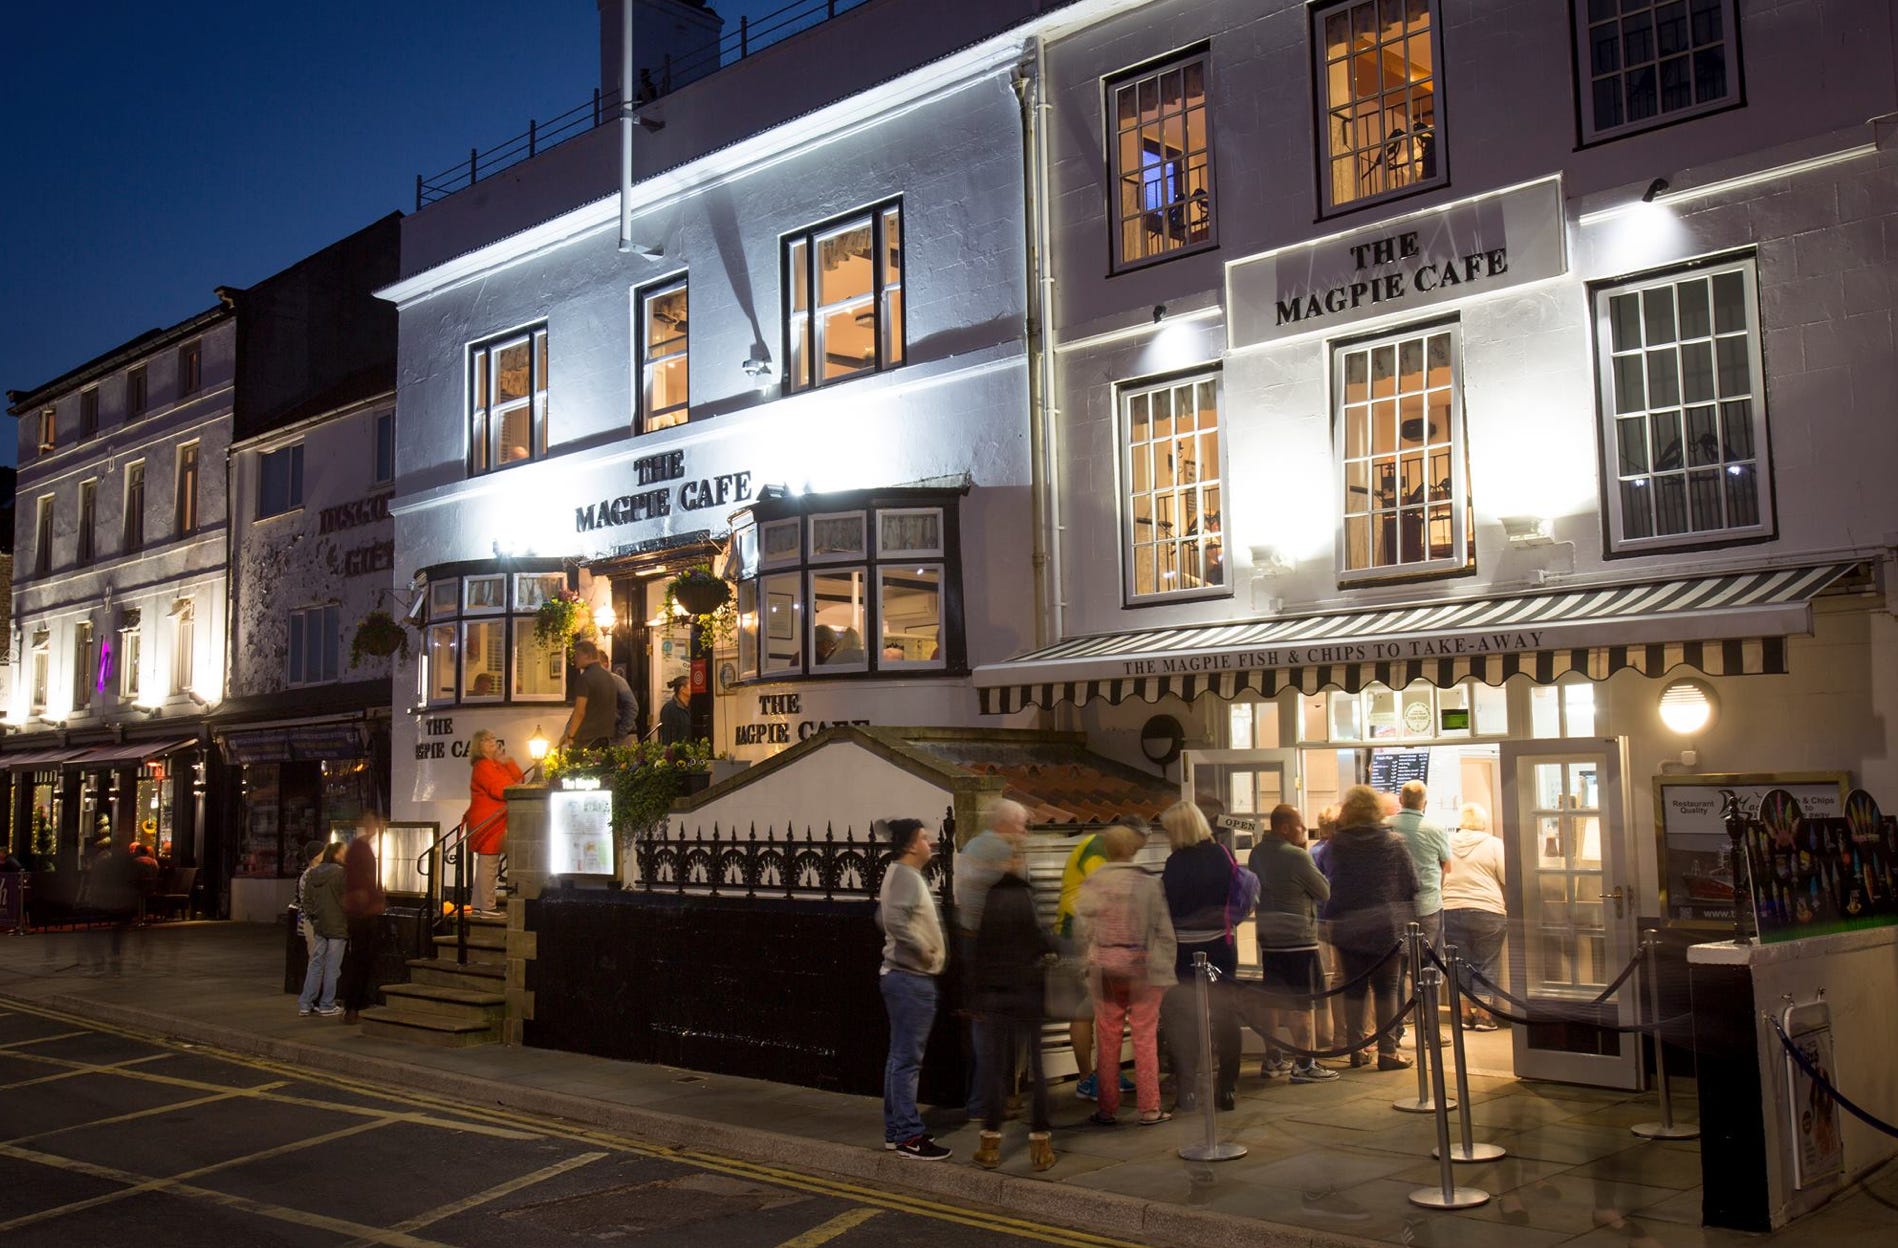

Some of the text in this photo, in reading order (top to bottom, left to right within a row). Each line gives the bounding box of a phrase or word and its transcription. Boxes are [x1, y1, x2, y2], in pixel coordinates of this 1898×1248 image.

[1351, 232, 1419, 271] THE
[1276, 248, 1508, 326] MAGPIE CAFE
[633, 450, 685, 486] THE
[575, 471, 751, 533] MAGPIE CAFE
[1123, 631, 1544, 675] THE MAGPIE FISH & CHIPS TO TAKE-AWAY
[759, 694, 800, 715] THE
[426, 717, 453, 735] THE
[1672, 800, 1714, 808] Restaurant
[1680, 807, 1708, 816] Quality
[1811, 796, 1835, 806] Chips
[1225, 818, 1256, 831] OPEN
